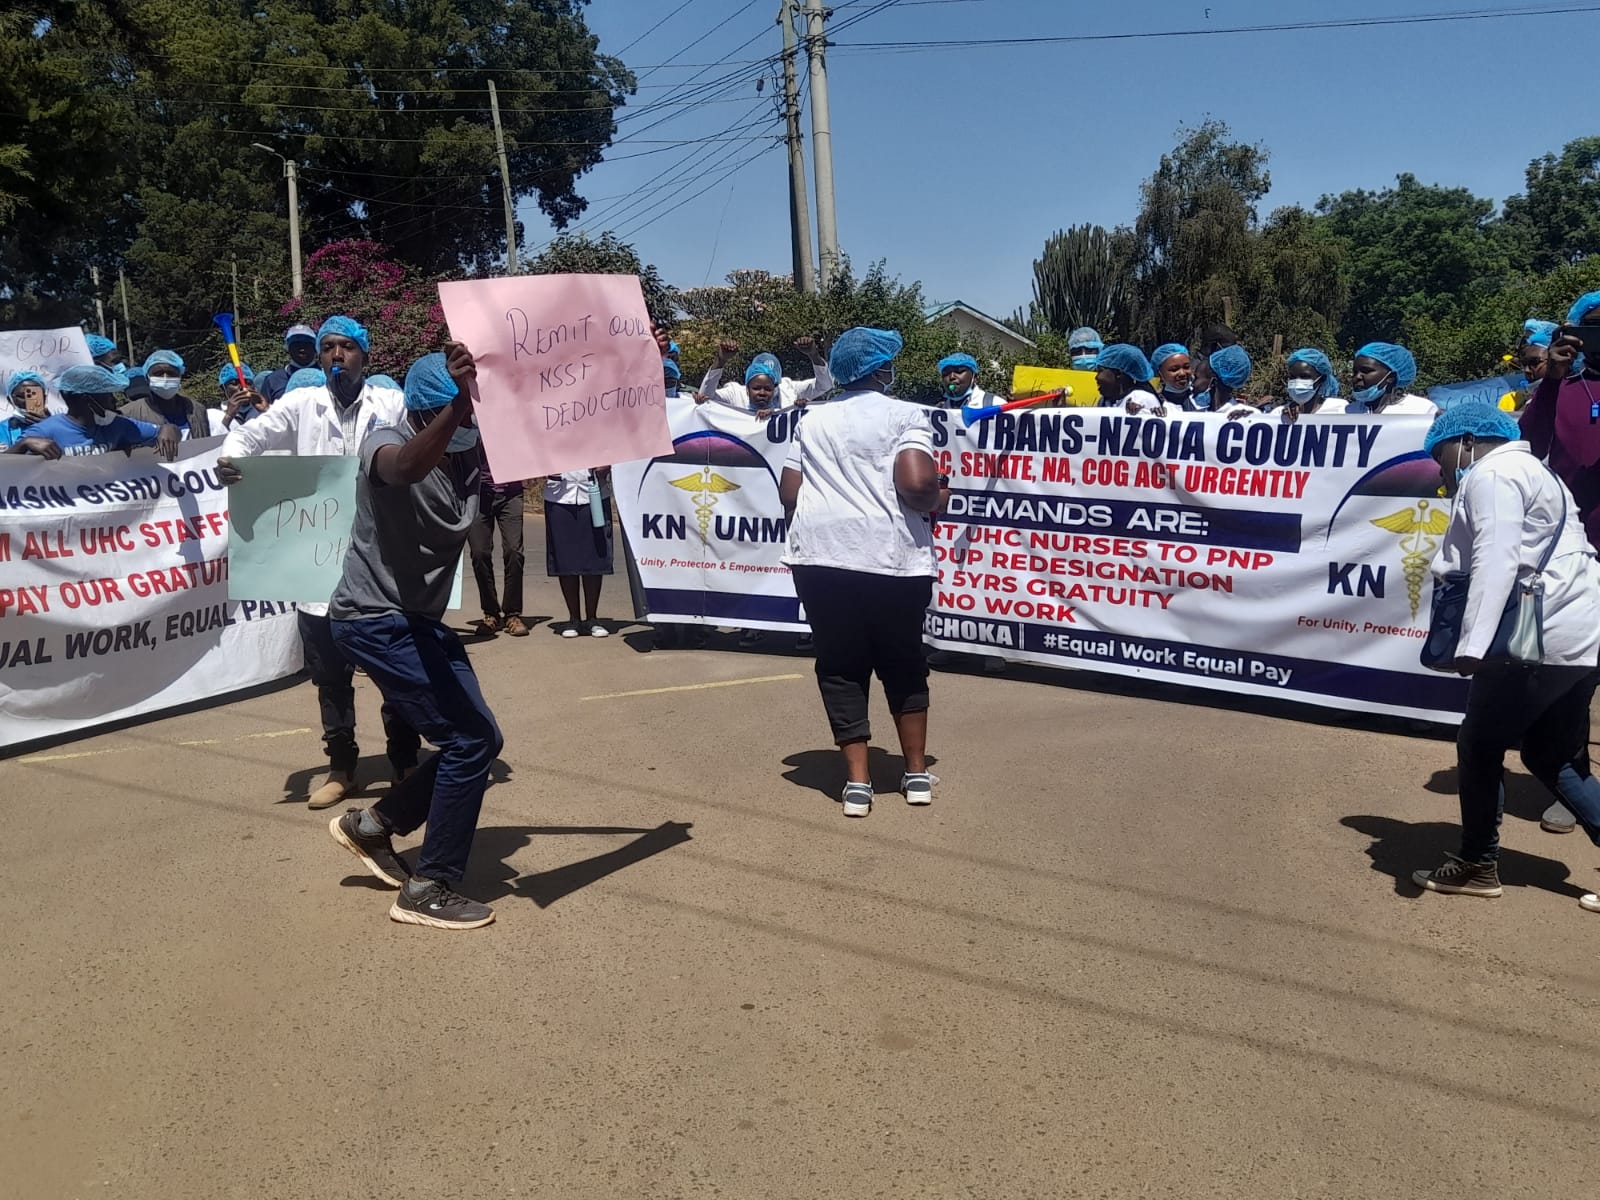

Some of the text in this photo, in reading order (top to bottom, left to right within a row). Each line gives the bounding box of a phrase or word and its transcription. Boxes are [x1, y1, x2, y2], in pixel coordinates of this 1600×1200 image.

[540, 353, 595, 392] NSSF
[978, 412, 1206, 462] TRANS-NZOIA
[1216, 421, 1382, 468] COUNTY
[77, 476, 161, 504] GISHU
[961, 451, 1037, 484] SENATE,
[1042, 456, 1077, 486] NA,
[1082, 458, 1129, 486] COG
[1135, 461, 1180, 490] ACT
[1184, 465, 1310, 499] URGENTLY
[276, 498, 339, 537] PNP
[642, 514, 786, 543] KN UNM
[947, 494, 1209, 536] DEMANDS ARE:
[22, 529, 73, 560] ALL
[80, 525, 135, 555] UHC
[139, 511, 229, 547] STAFF
[966, 525, 1022, 547] UHC
[1030, 532, 1148, 558] NURSES
[1158, 543, 1197, 563] TO
[1207, 548, 1274, 570] PNP
[640, 557, 667, 568] Unity,
[719, 561, 727, 570] &
[992, 552, 1233, 593] REDESIGNATION
[1328, 562, 1387, 598] KN
[0, 585, 49, 617] PAY
[60, 577, 125, 609] OUR
[938, 591, 1077, 623] NO WORK
[952, 571, 1018, 593] 5YRS
[1026, 578, 1174, 610] GRATUITY
[66, 621, 157, 659] WORK,
[165, 603, 236, 641] EQUAL
[1297, 616, 1319, 628] For
[923, 613, 1293, 686] ECHOKA #Equal Work Equal Pay
